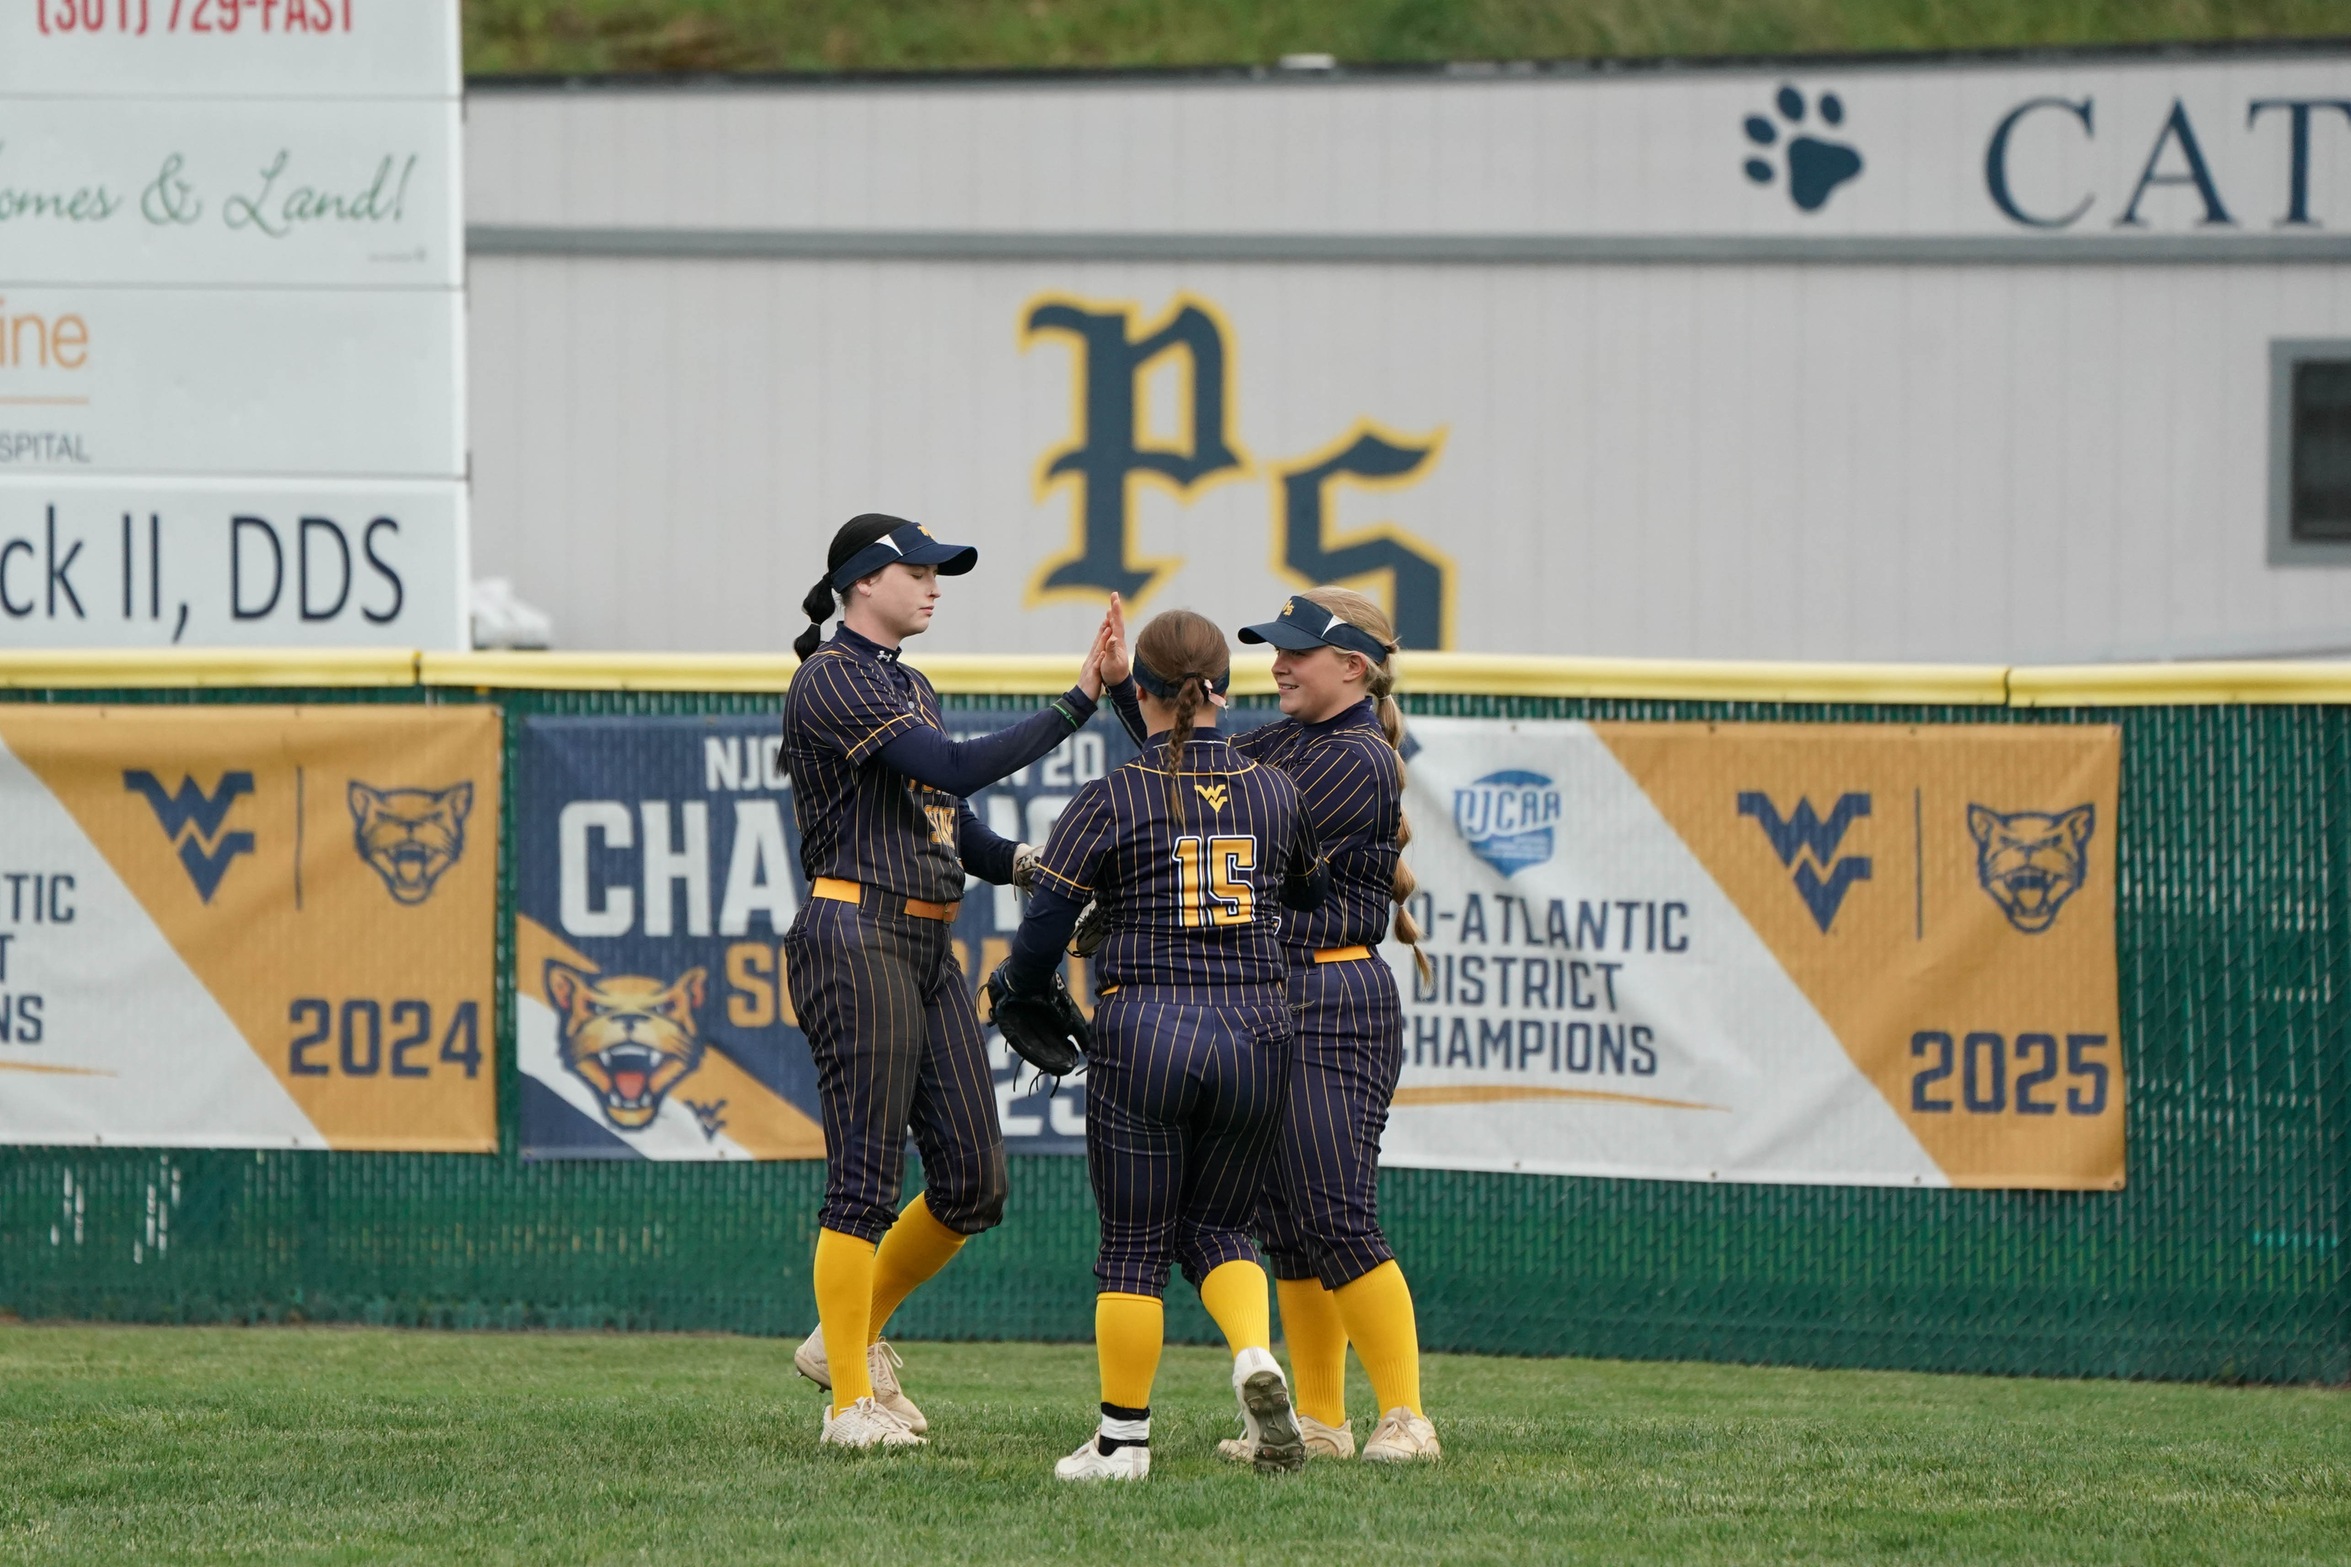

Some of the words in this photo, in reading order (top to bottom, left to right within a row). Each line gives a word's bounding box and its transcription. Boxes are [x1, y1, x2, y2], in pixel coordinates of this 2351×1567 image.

[0, 184, 121, 222] omes
[141, 152, 202, 226] &
[222, 149, 417, 238] Land!
[1984, 95, 2351, 230] CAT
[1, 504, 85, 619] ck
[231, 514, 404, 623] DDS
[704, 735, 792, 791] NJC
[1172, 835, 1256, 927] 15
[289, 999, 482, 1079] 2024
[1910, 1030, 2109, 1116] 2025
